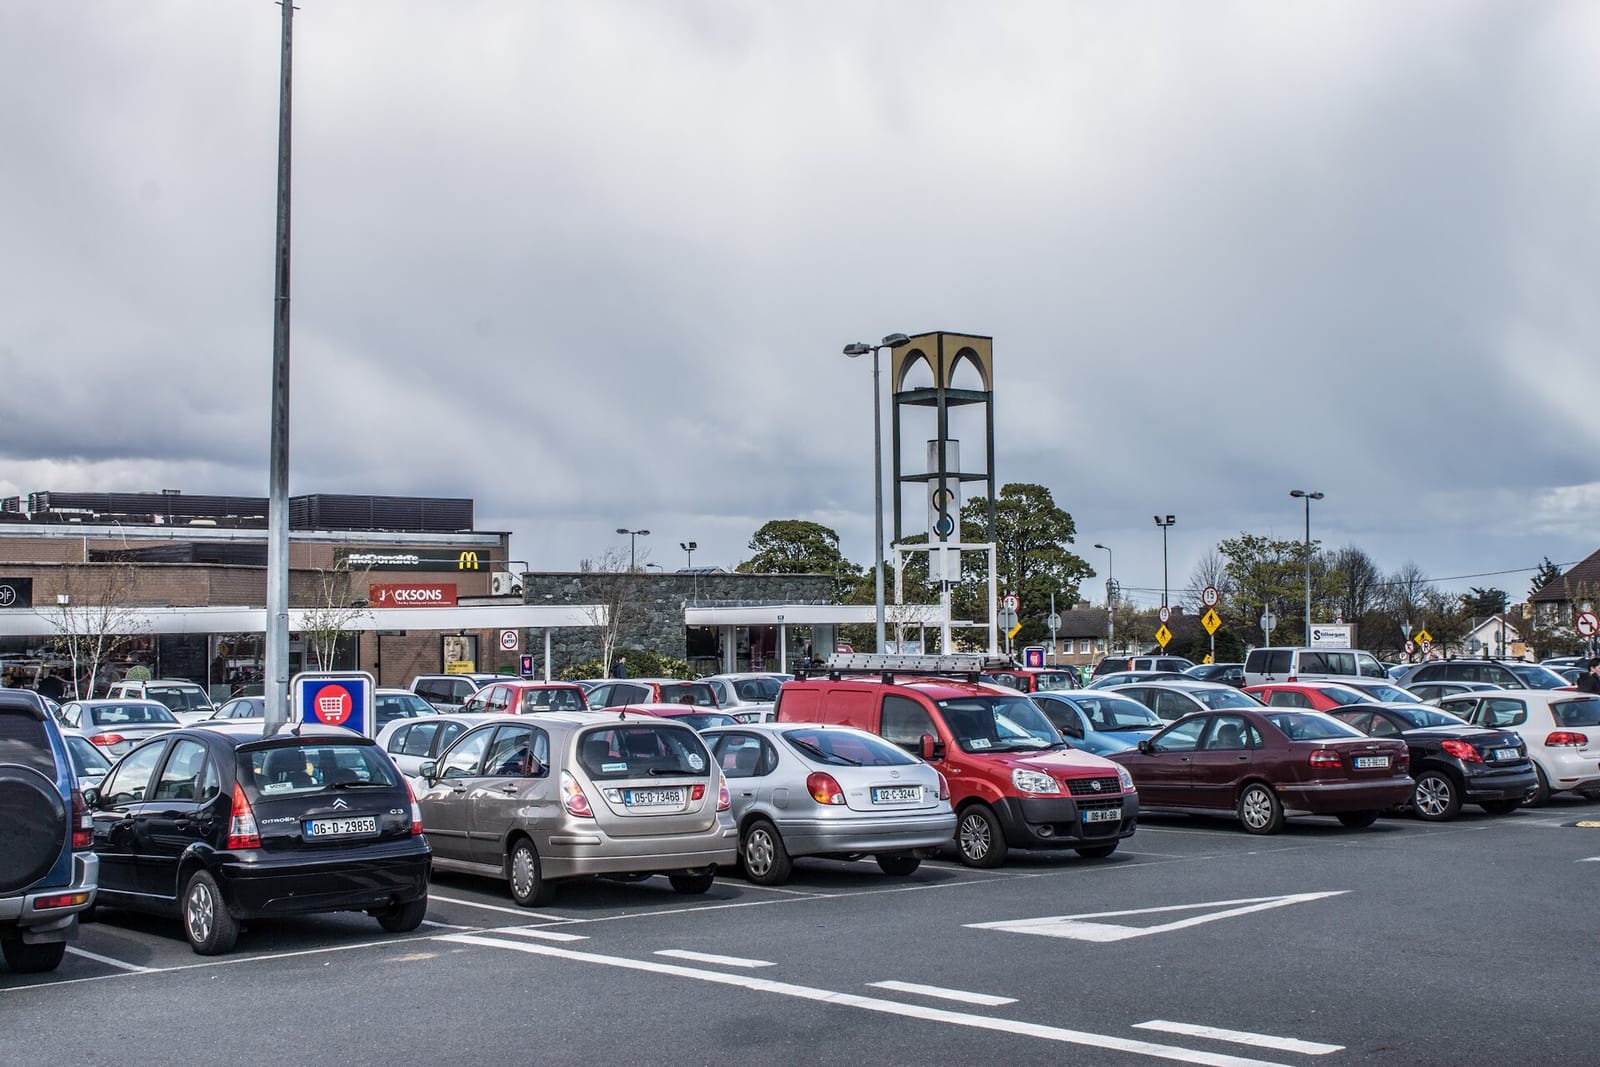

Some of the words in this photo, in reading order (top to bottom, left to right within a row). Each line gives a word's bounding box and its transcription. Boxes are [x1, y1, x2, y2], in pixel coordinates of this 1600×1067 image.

[348, 554, 419, 564] McDonald's
[1206, 590, 1215, 600] 15
[880, 788, 915, 800] 02-C-3244
[313, 819, 375, 835] 06-D-29858
